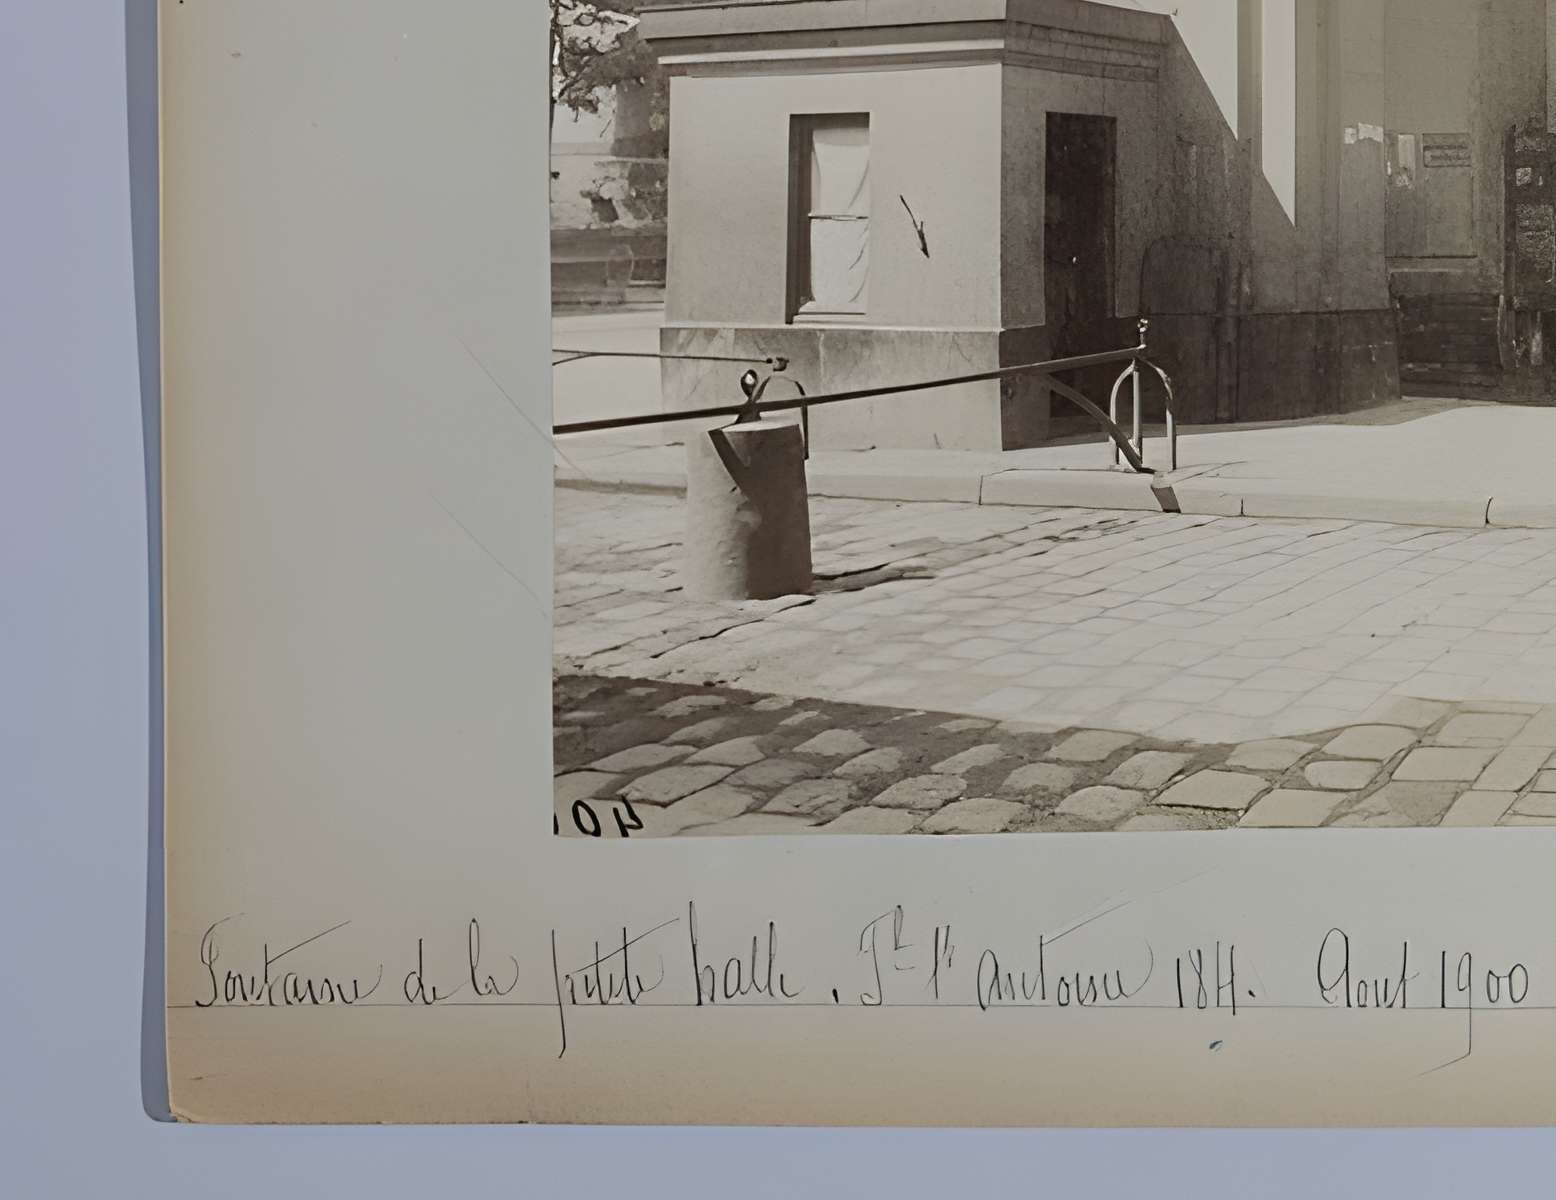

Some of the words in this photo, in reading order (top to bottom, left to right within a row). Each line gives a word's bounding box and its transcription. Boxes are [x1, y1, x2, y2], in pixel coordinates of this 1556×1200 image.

[195, 911, 384, 1007] Fontaine
[403, 937, 456, 1006] de
[467, 916, 520, 1000] la
[1425, 950, 1530, 1072] 1900
